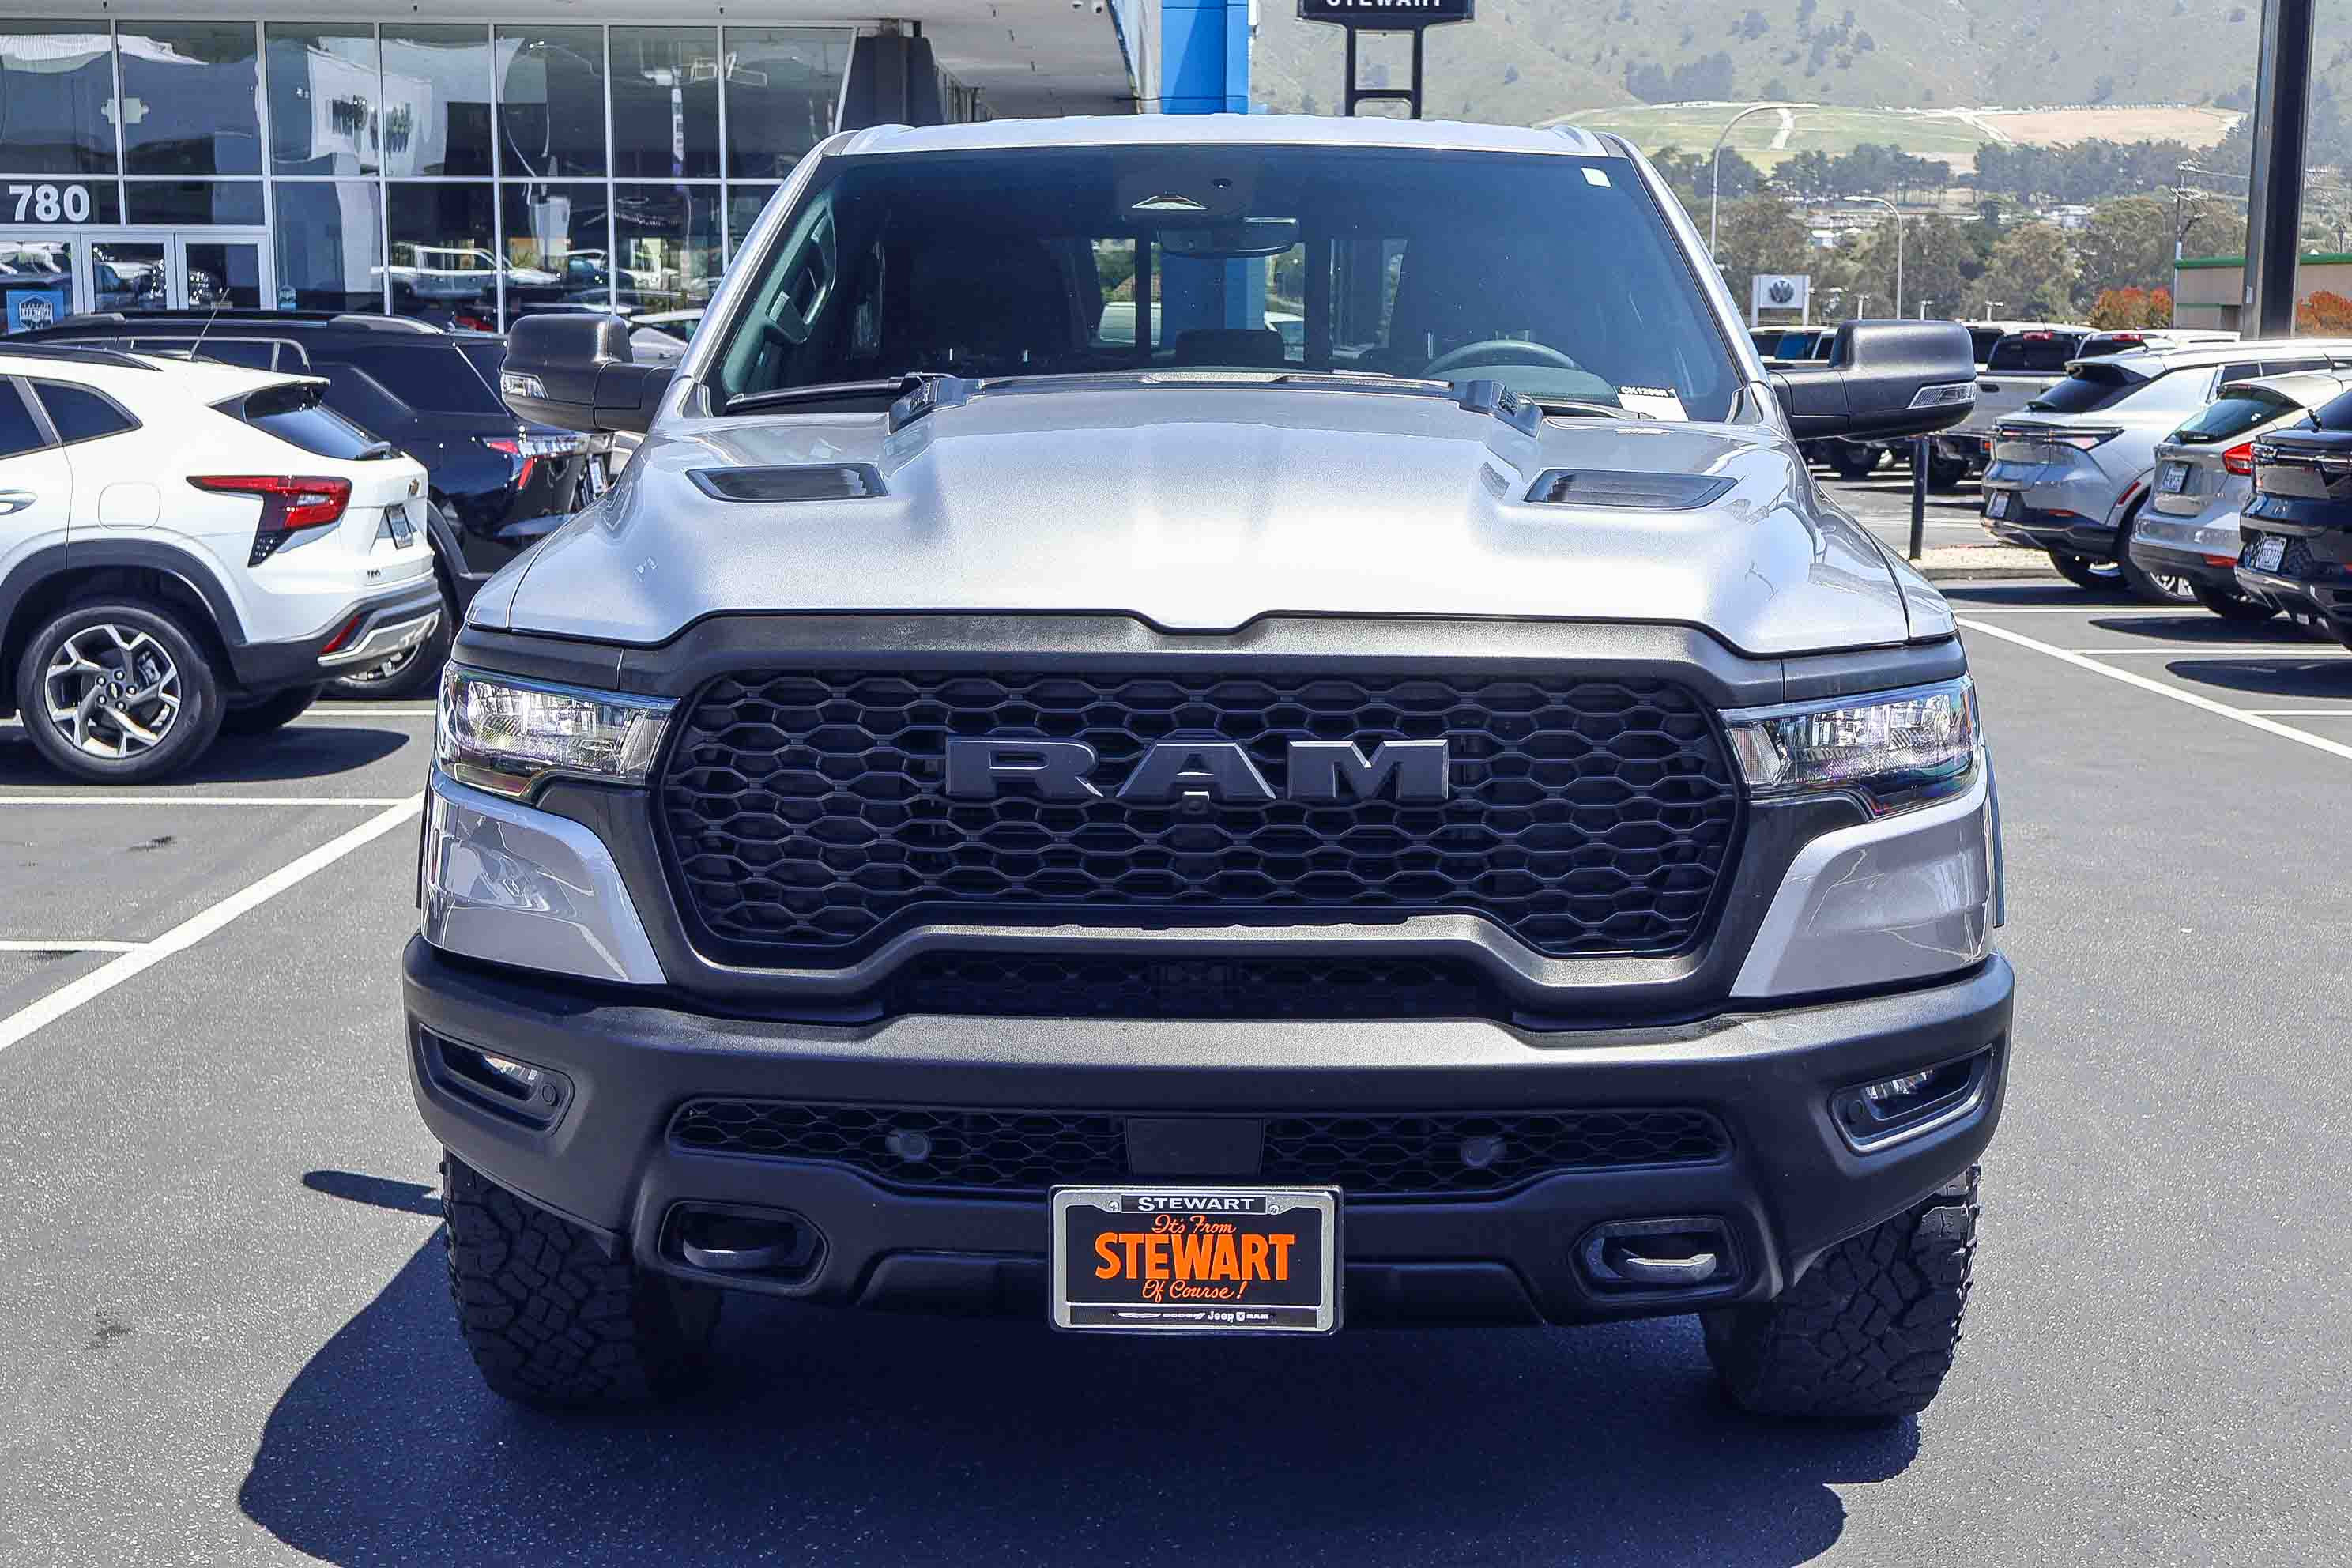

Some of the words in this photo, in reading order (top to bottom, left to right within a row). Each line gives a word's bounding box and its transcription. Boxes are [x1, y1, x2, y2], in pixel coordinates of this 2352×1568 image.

[9, 184, 90, 222] 780
[945, 739, 1449, 802] RAM
[1137, 1197, 1255, 1212] STEWART
[1151, 1214, 1185, 1234] It's
[1190, 1215, 1237, 1234] From
[1094, 1231, 1296, 1280] STEWART
[1142, 1280, 1164, 1303] Of
[1208, 1310, 1234, 1323] Jeep
